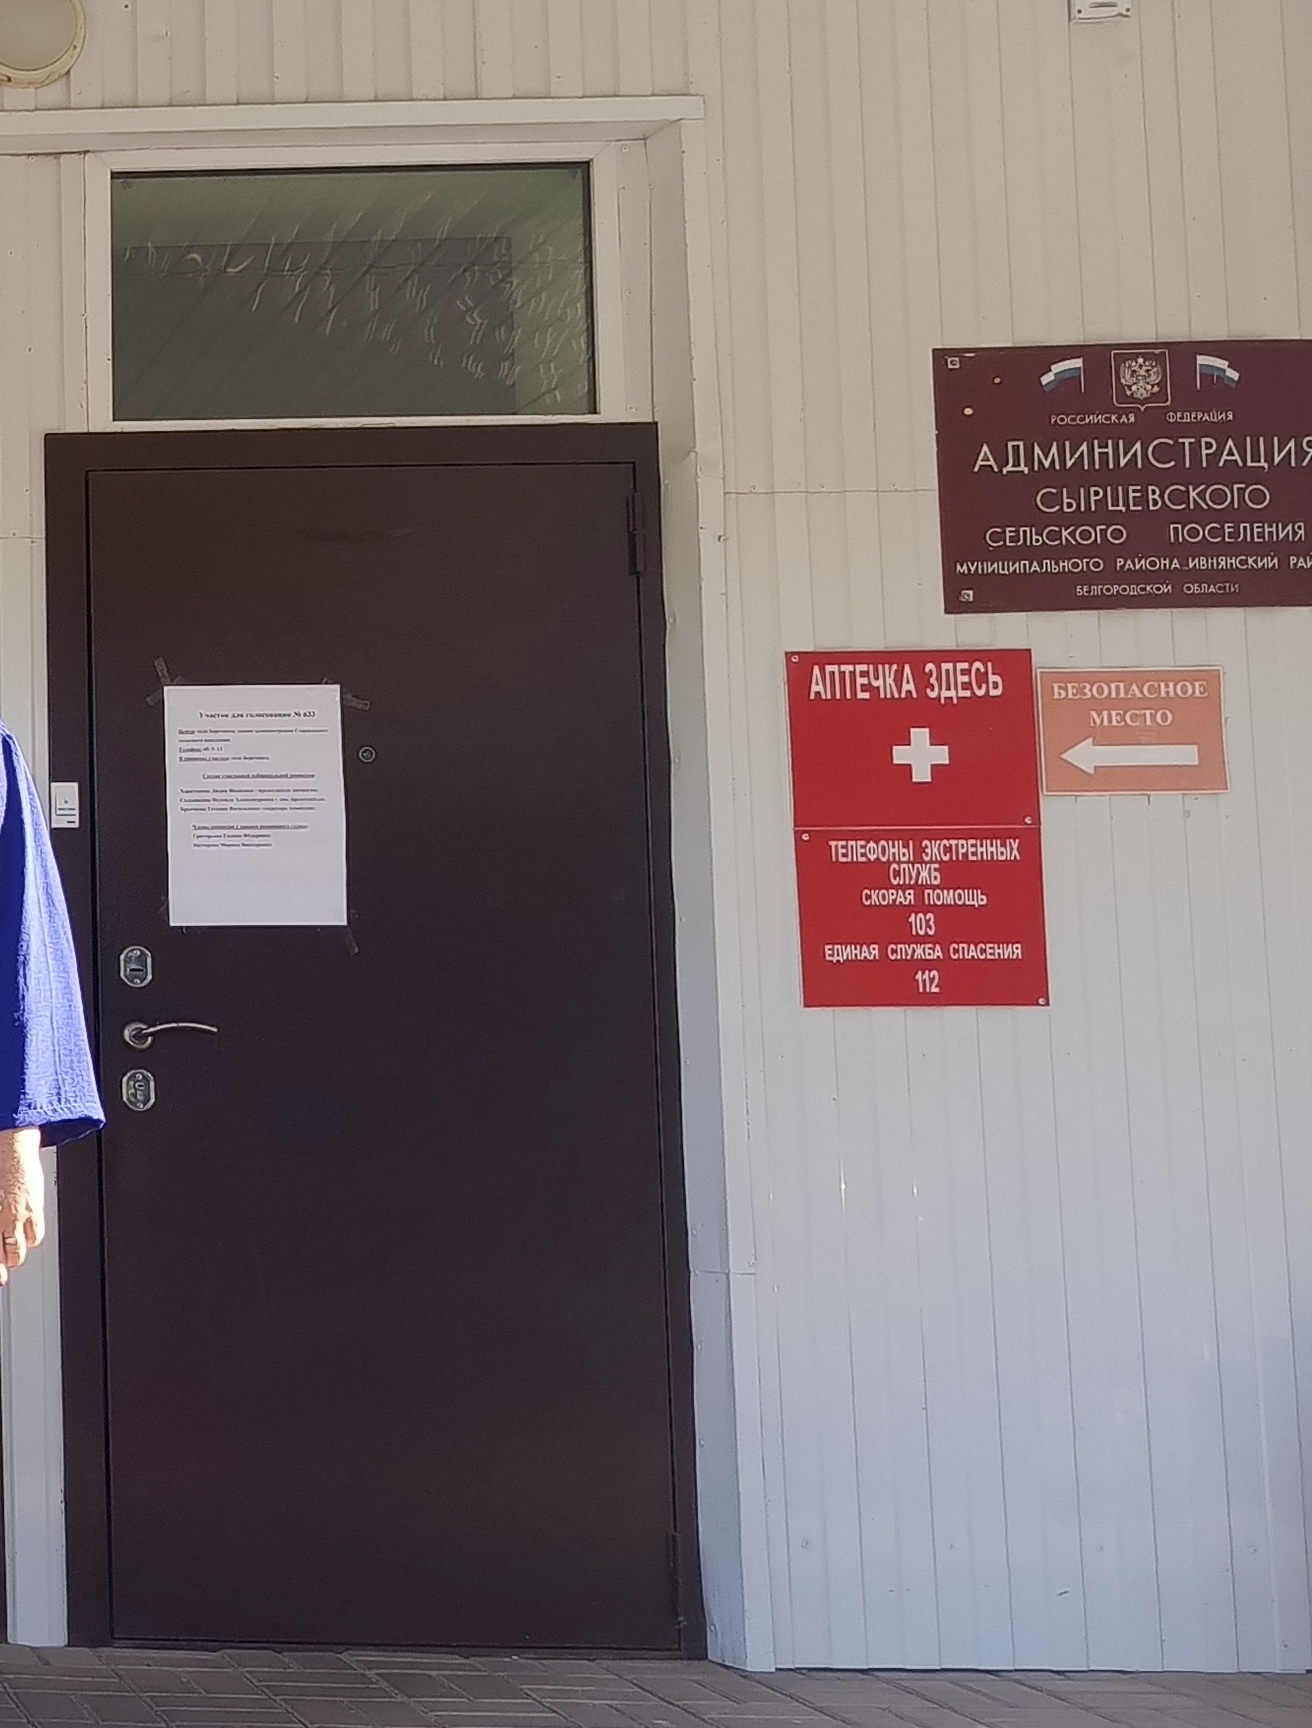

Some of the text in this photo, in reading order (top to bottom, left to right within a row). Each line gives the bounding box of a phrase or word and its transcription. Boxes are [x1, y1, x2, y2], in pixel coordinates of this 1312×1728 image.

[1050, 408, 1234, 426] РОССИЙСКАЯ ФЕДЕРАЦИЯ
[1036, 483, 1270, 513] СЫРЦЕВСКОГО
[984, 522, 1306, 548] СЕЛЬСКОГО ПОСЕЛЕНИЯ
[955, 557, 1104, 576] МУНИЦИПАЛЬНОГО
[1116, 553, 1182, 572] РАЙОНА
[1076, 580, 1240, 597] БЕЛГОРОДСКОЙ ОБЛАСТИ
[809, 661, 1004, 704] АПТЕЧКА ЗДЕСЬ
[1051, 680, 1209, 700] БЕЗОПАСНОЕ
[1089, 709, 1174, 727] МЕСТО
[828, 838, 1021, 863] ТЕЛЕФОНЫ ЭКСТРЕННЫХ
[889, 863, 941, 886] СЛУЖБ
[861, 889, 988, 908] СКОРАЯ ПОМОЩЬ
[908, 912, 936, 936] 103
[824, 943, 1023, 963] ЕДИНАЯ СЛУЖБА СПАСЕНИЯ
[914, 970, 941, 994] 112
